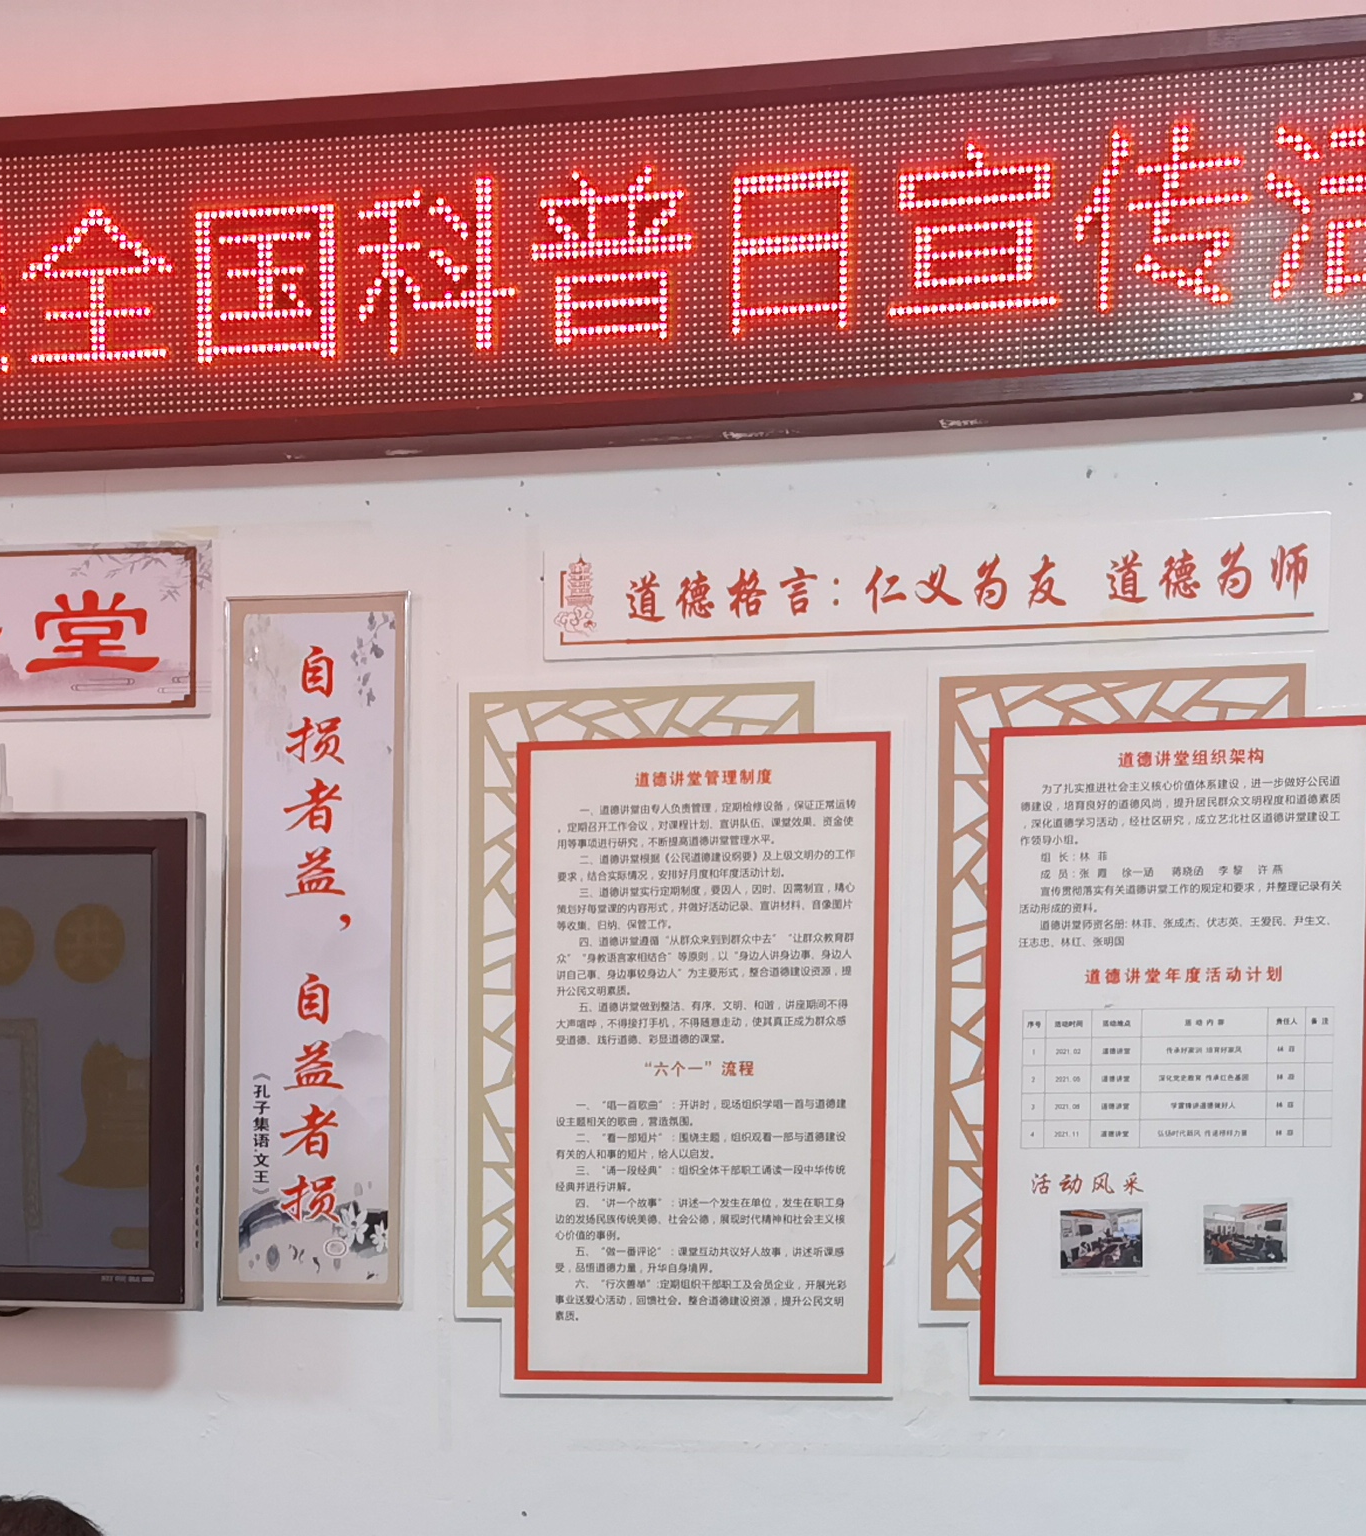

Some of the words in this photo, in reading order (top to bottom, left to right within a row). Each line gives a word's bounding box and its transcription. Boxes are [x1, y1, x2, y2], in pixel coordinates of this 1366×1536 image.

[1105, 542, 1310, 604] 道德为师
[1118, 748, 1265, 768] 道德讲堂组织架构
[635, 768, 773, 788] 道德讲堂管理制度
[1020, 833, 1079, 847] 作领导小组。
[1019, 902, 1099, 915] 活动形成的资料。
[1084, 966, 1284, 986] 道德讲堂年度活动计划
[555, 1180, 632, 1194] 经典并进行讲解。
[1031, 1171, 1145, 1196] 活动风采
[555, 1229, 621, 1243] 心价值的事例。
